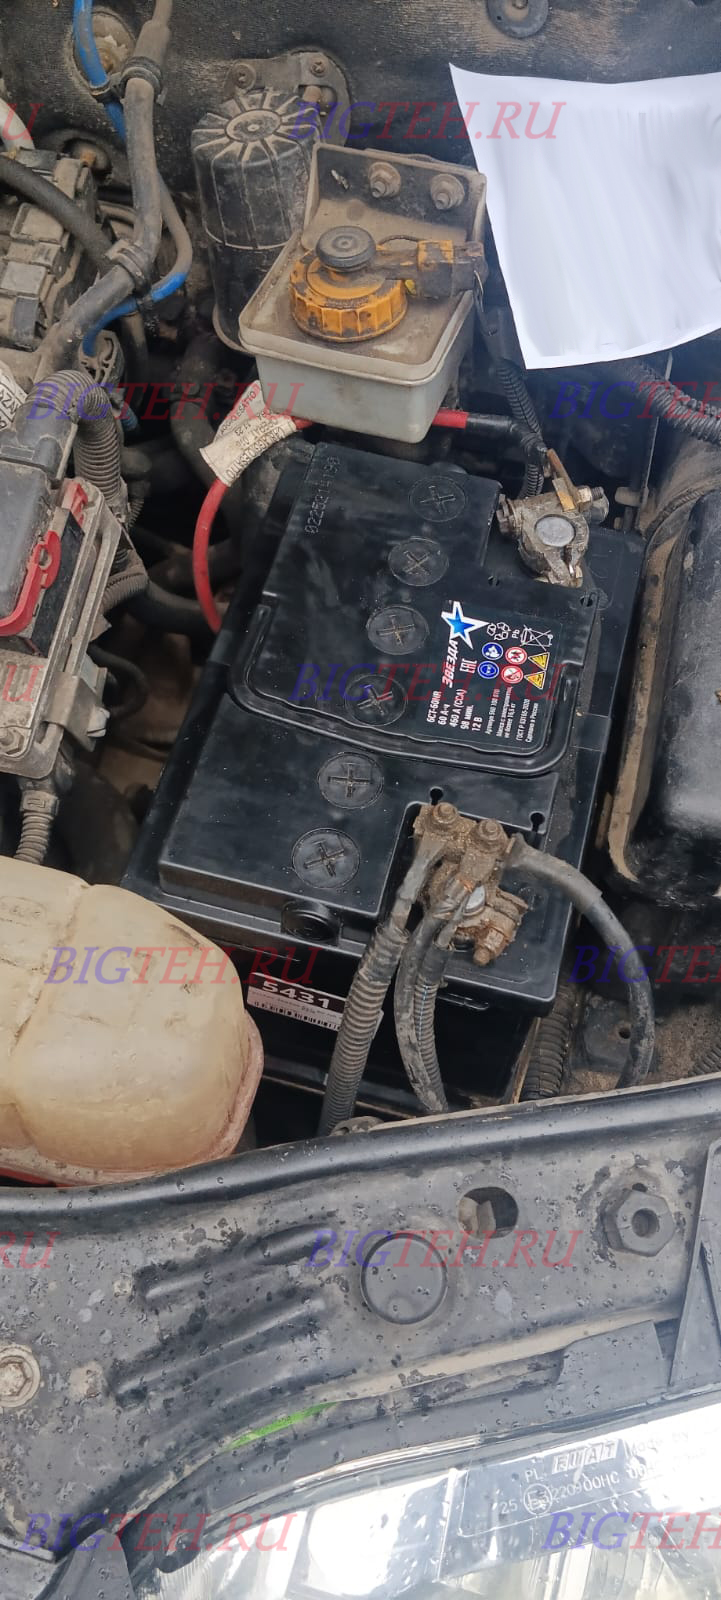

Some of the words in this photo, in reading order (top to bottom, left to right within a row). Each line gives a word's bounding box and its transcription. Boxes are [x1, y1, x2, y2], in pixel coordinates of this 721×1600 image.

[512, 629, 520, 639] Pb
[442, 640, 459, 688] ЗВЕЗДА
[438, 716, 447, 725] 60
[460, 720, 470, 730] 98
[472, 722, 482, 731] 12
[515, 728, 525, 741] ГОСТ
[262, 981, 330, 1009] 5431
[499, 1498, 518, 1515] 25
